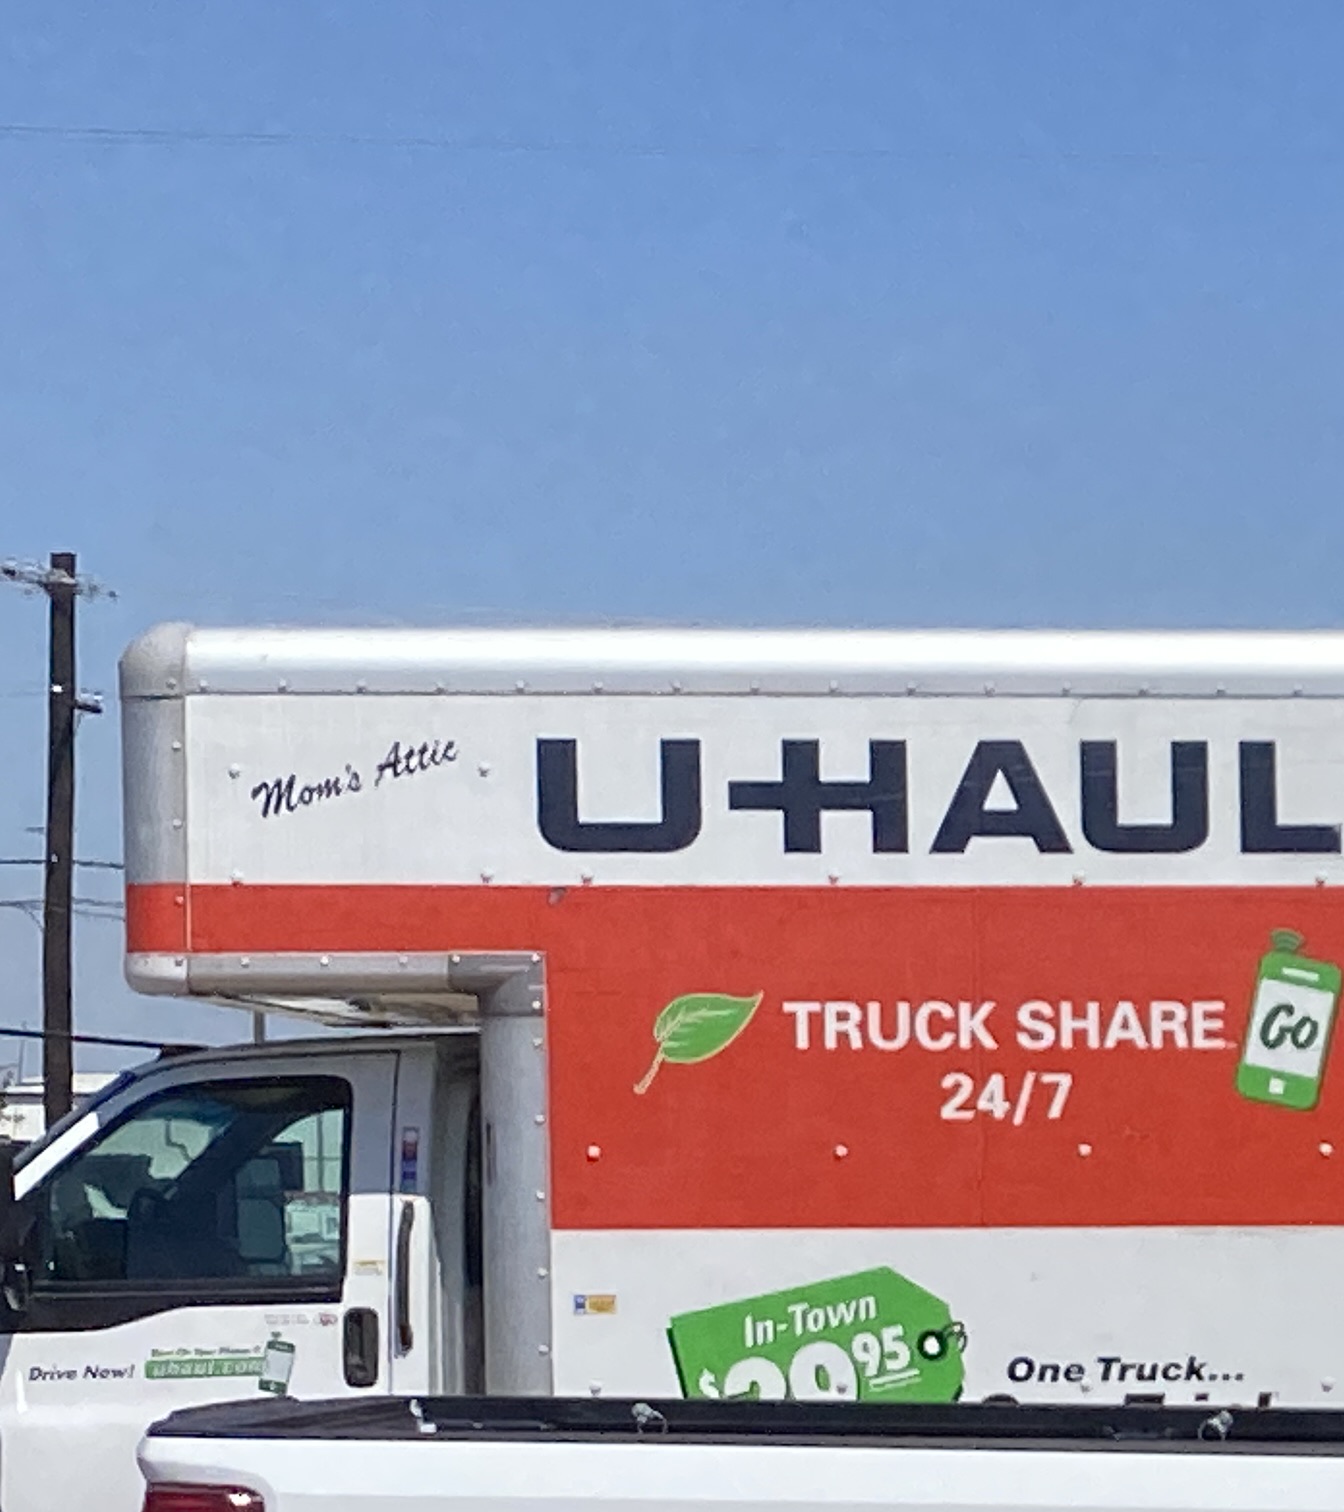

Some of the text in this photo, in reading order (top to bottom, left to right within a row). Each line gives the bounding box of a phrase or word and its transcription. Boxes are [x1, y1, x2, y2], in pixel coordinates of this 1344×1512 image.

[250, 740, 459, 819] Mom's Attic
[536, 738, 1342, 853] U-HAUL
[782, 1000, 1226, 1051] TRUCK SHARE
[1260, 1004, 1319, 1050] Go
[940, 1071, 1073, 1126] 24/7
[743, 1295, 878, 1348] In-Town
[28, 1364, 136, 1382] Drive Now!
[1007, 1354, 1245, 1383] One Truck...
